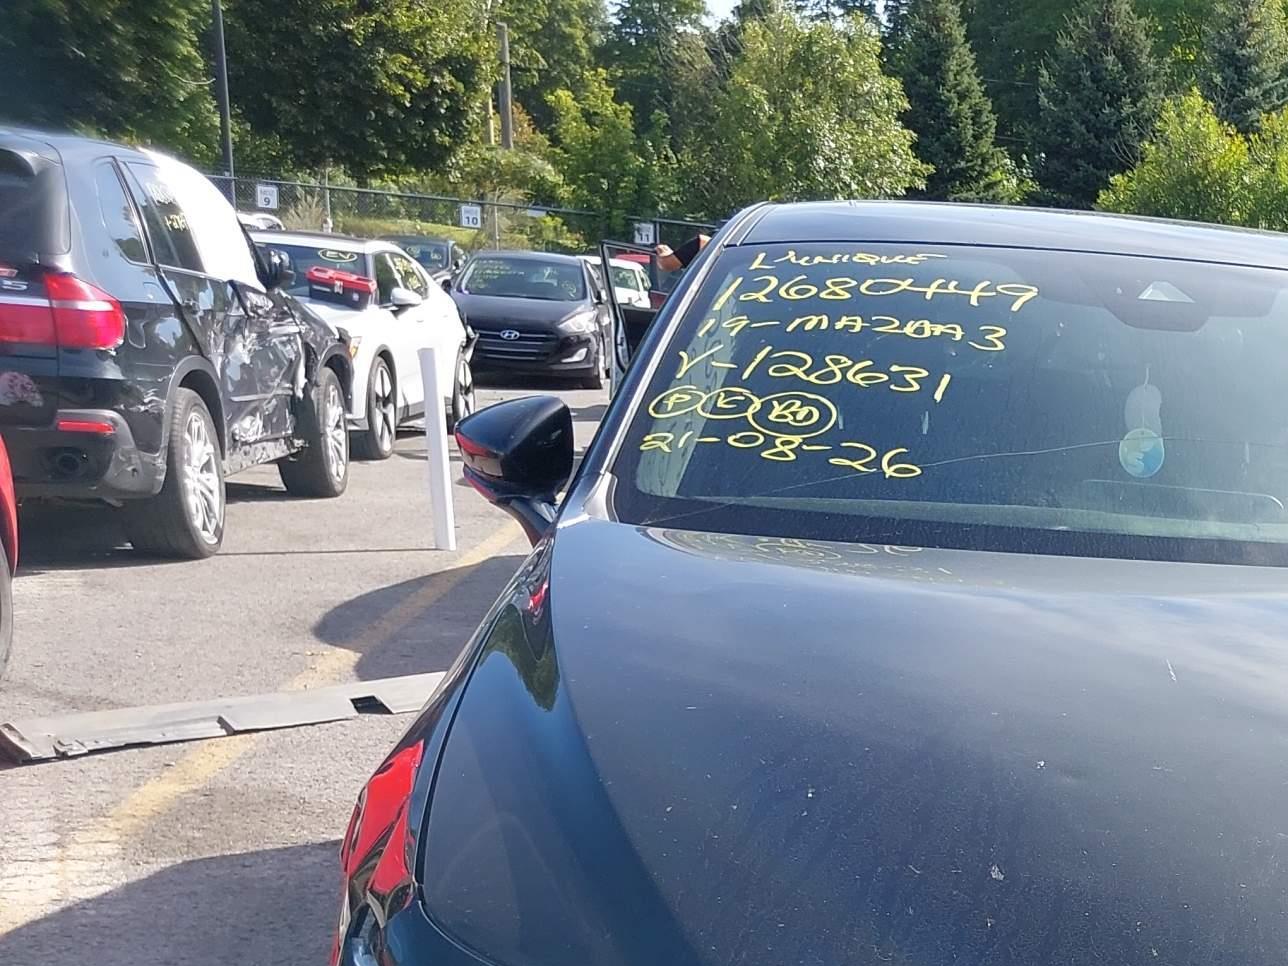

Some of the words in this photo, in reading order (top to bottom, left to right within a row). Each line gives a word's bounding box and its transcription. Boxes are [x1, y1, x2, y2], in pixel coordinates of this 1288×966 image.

[465, 216, 478, 225] 10
[712, 276, 1039, 312] 12680449
[640, 431, 922, 479] 21-08-26
